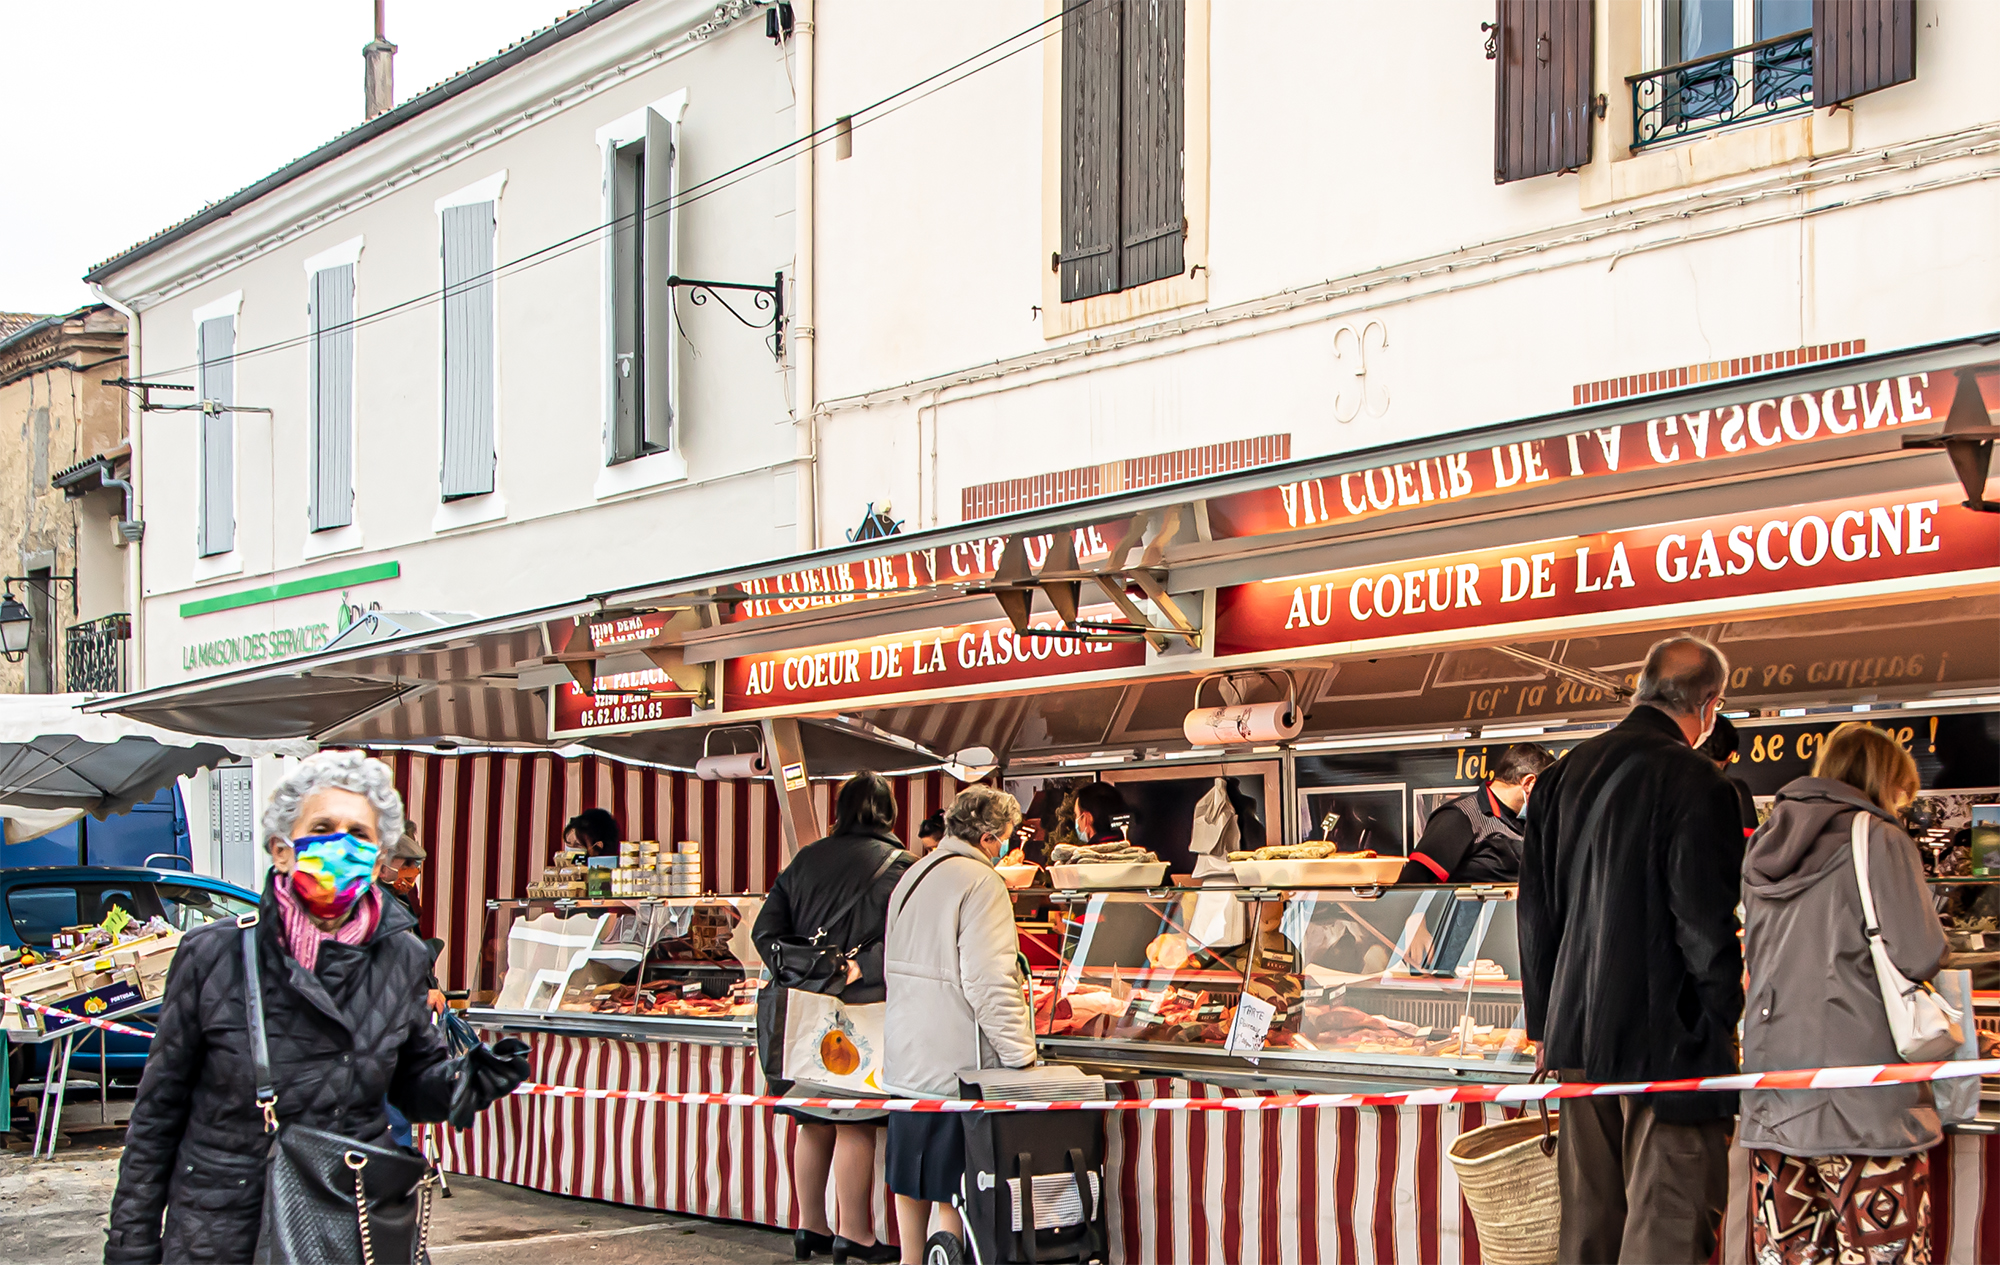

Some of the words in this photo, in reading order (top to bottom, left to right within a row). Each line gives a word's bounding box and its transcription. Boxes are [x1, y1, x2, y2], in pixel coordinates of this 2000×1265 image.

[1284, 582, 1334, 630] AU
[1349, 562, 1482, 621] COEUR
[1500, 551, 1556, 604] DE
[1574, 541, 1636, 594] LA
[1655, 499, 1940, 583] GASCOGNE
[182, 645, 198, 670] LA
[199, 636, 241, 666] MAISON
[242, 632, 266, 661] DES
[268, 622, 330, 657] SERVICES
[745, 660, 775, 695] AU
[783, 649, 860, 691] COEUR
[870, 642, 903, 680] DE
[912, 636, 947, 675] LA
[581, 701, 662, 727] 05.62.08.50.85
[1455, 747, 1495, 781] Ici,
[1750, 734, 1785, 763] se
